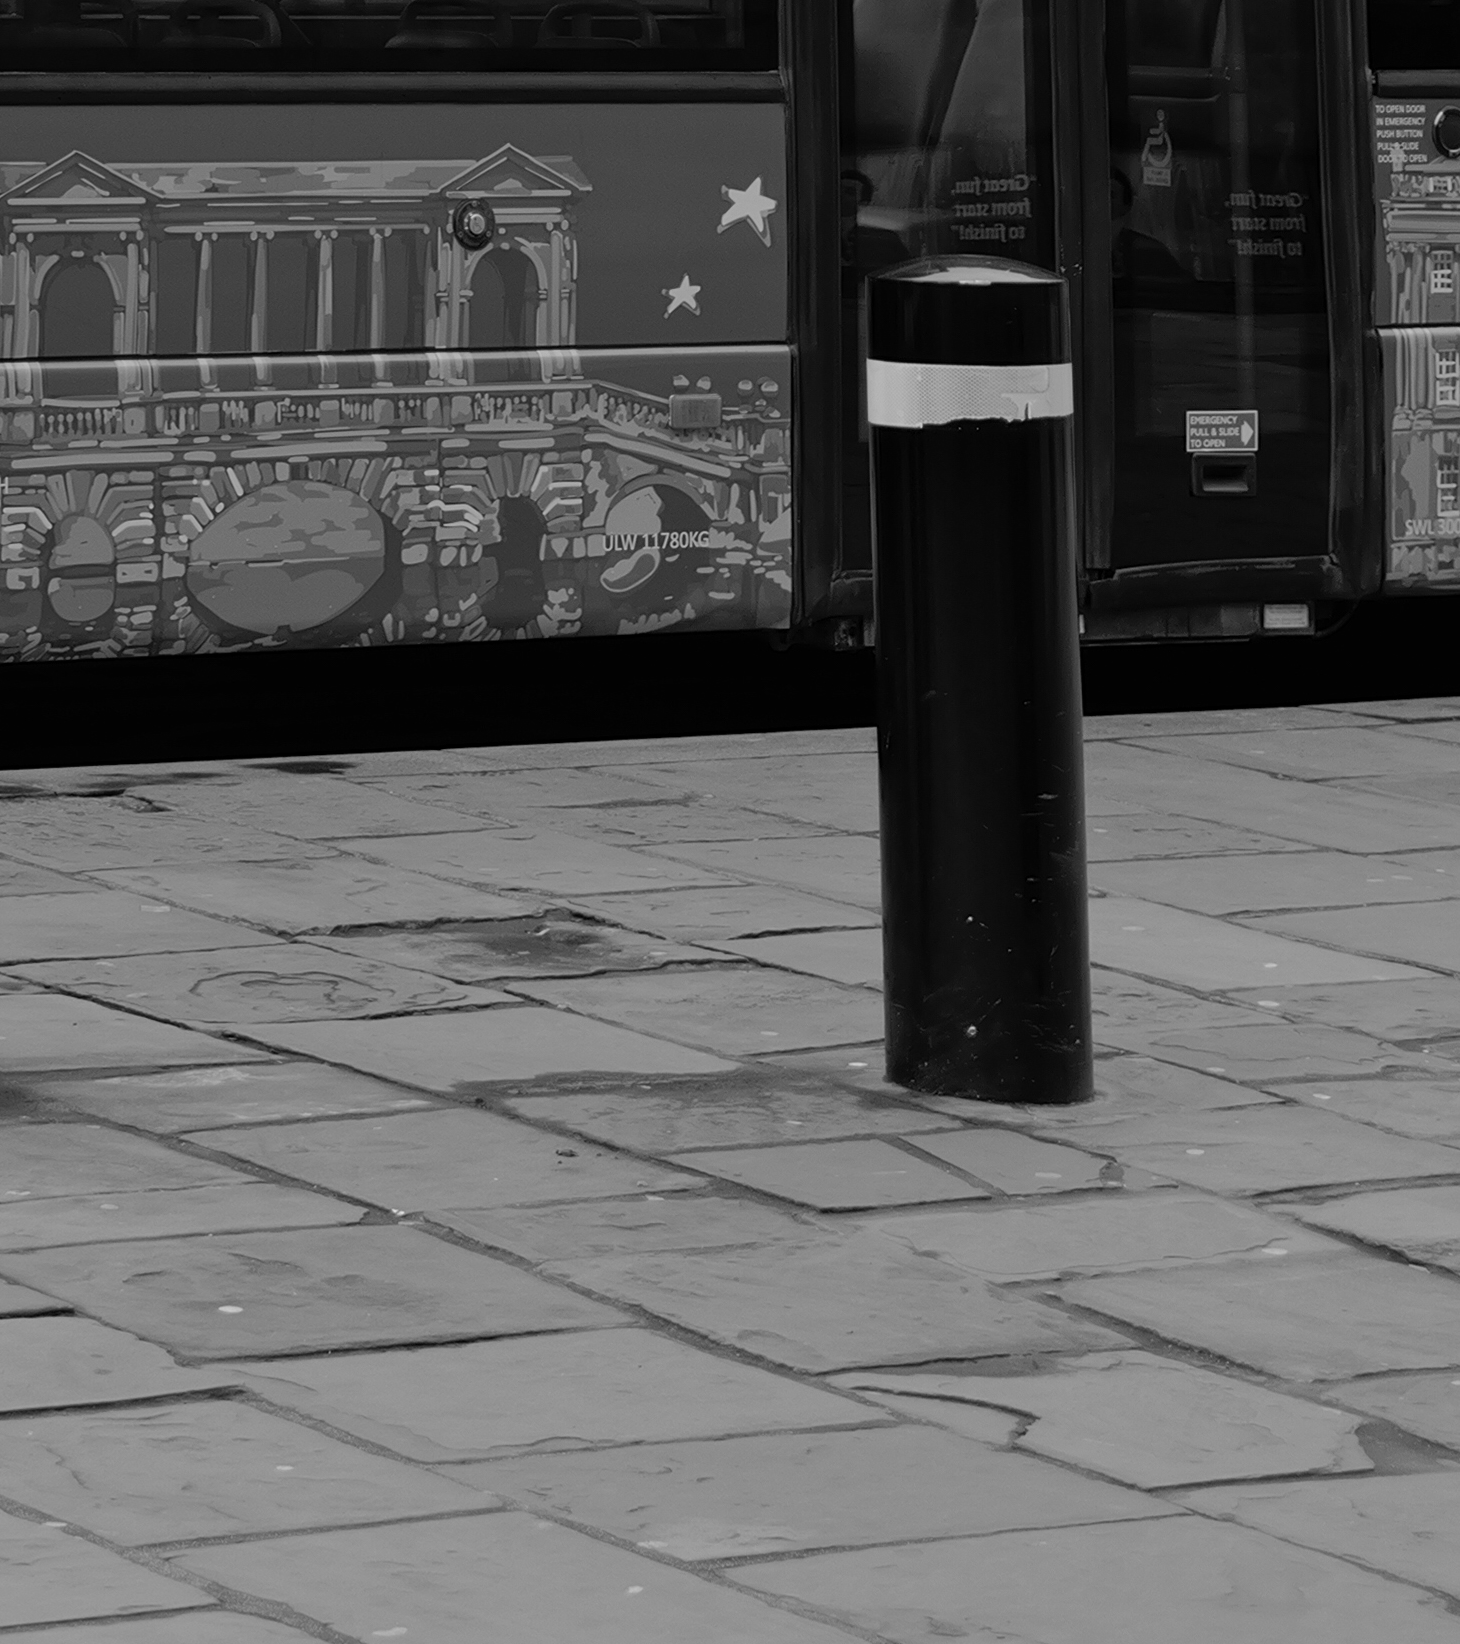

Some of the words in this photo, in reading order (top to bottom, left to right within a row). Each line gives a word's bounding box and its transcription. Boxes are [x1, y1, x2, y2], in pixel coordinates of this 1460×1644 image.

[1375, 105, 1386, 113] TO
[1386, 105, 1405, 113] OPEN
[1405, 105, 1426, 113] DOOR
[1376, 117, 1385, 126] IN
[1385, 117, 1426, 126] EMERGENCY
[1376, 129, 1395, 138] PUSH
[1396, 129, 1424, 138] BUTTON
[1401, 142, 1419, 150] SLIDE
[1409, 154, 1428, 163] OPEN
[1190, 416, 1238, 425] EMERGENCY
[1190, 427, 1210, 436] PULL
[1211, 427, 1218, 436] &
[1218, 427, 1240, 436] SLIDE
[1190, 439, 1202, 448] TO
[1203, 439, 1226, 448] OPEN
[1405, 519, 1435, 535] SWL
[602, 533, 638, 552] ULW
[642, 530, 710, 550] 11780KG
